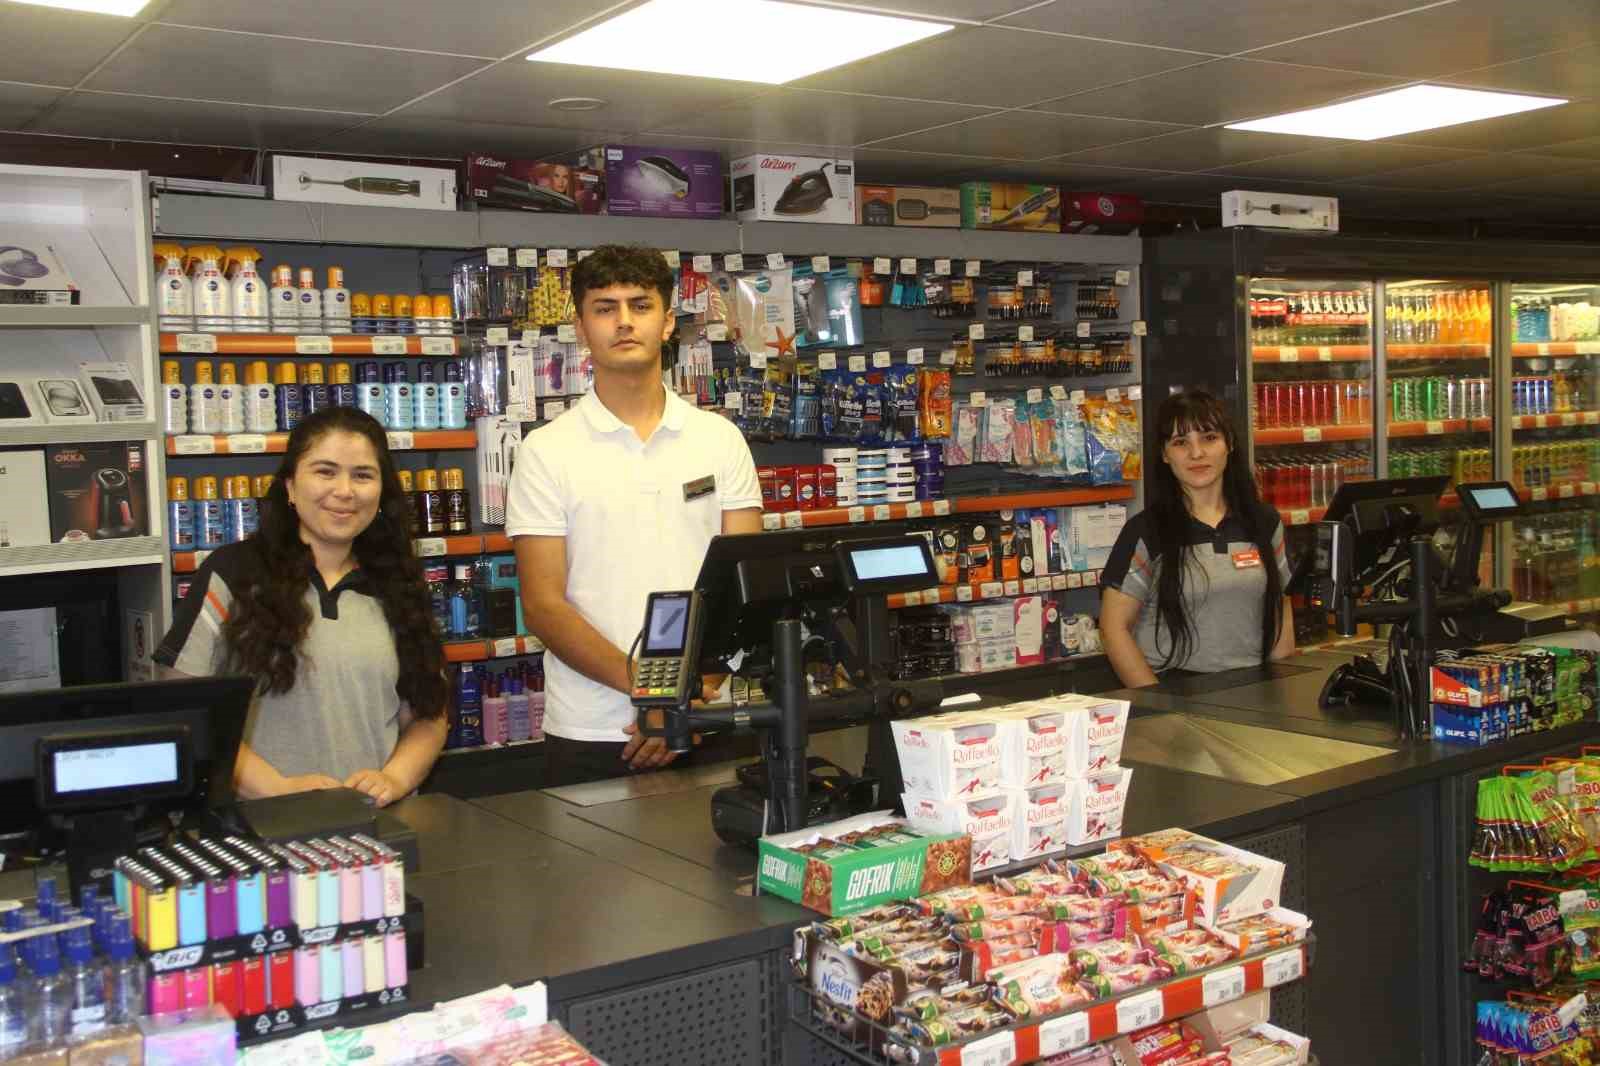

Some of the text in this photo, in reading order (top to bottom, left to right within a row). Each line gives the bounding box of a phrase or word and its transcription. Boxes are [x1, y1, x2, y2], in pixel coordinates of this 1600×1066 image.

[846, 862, 895, 900] GOFRIK
[166, 951, 195, 965] BIC
[821, 972, 852, 1001] Nesfit
